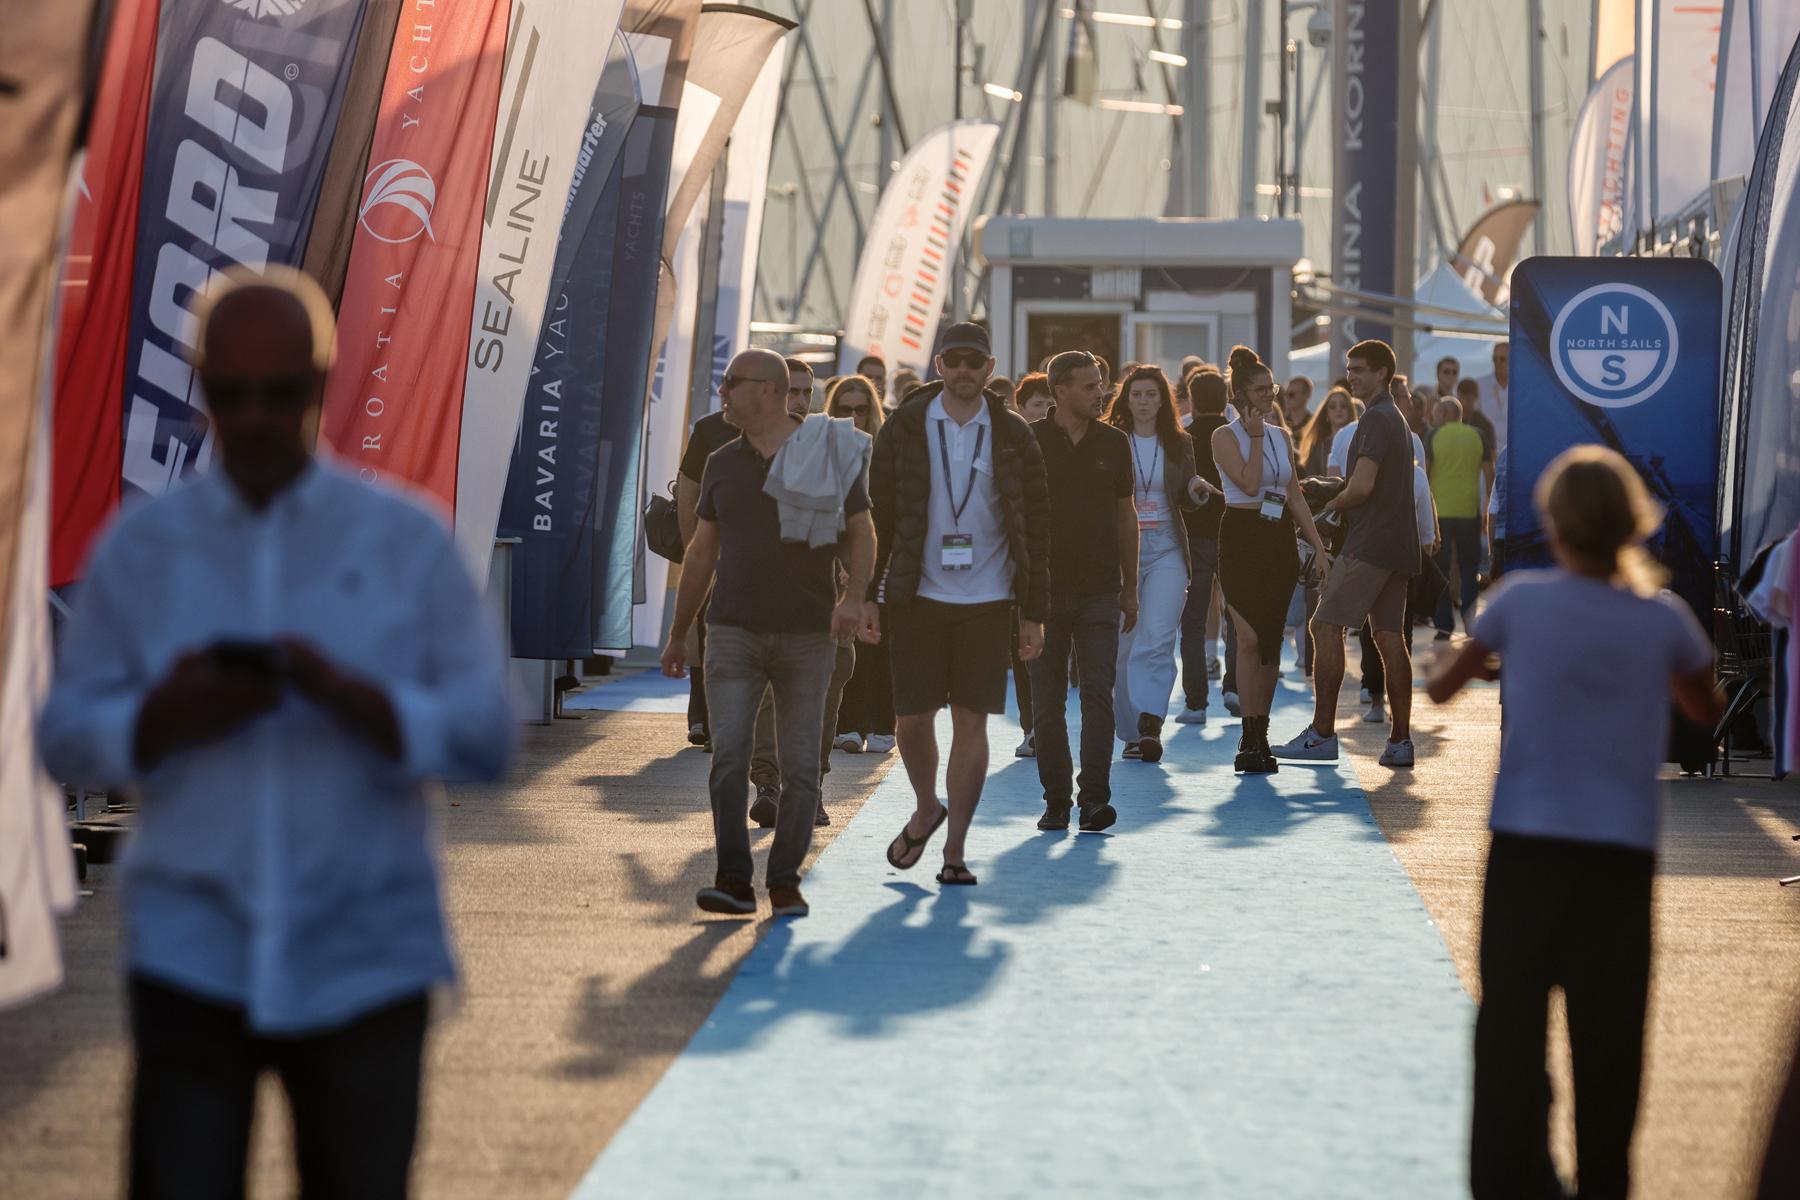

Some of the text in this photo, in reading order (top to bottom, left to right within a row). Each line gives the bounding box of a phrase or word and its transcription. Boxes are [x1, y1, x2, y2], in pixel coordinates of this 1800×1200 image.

[475, 149, 550, 373] SEALINE
[1343, 0, 1366, 343] ARINA KORN
[360, 272, 403, 486] CROATIA
[533, 292, 570, 532] BAVARIA YAC
[1566, 339, 1662, 349] NORTH SAILS
[1601, 305, 1629, 335] N
[1601, 354, 1627, 387] S
